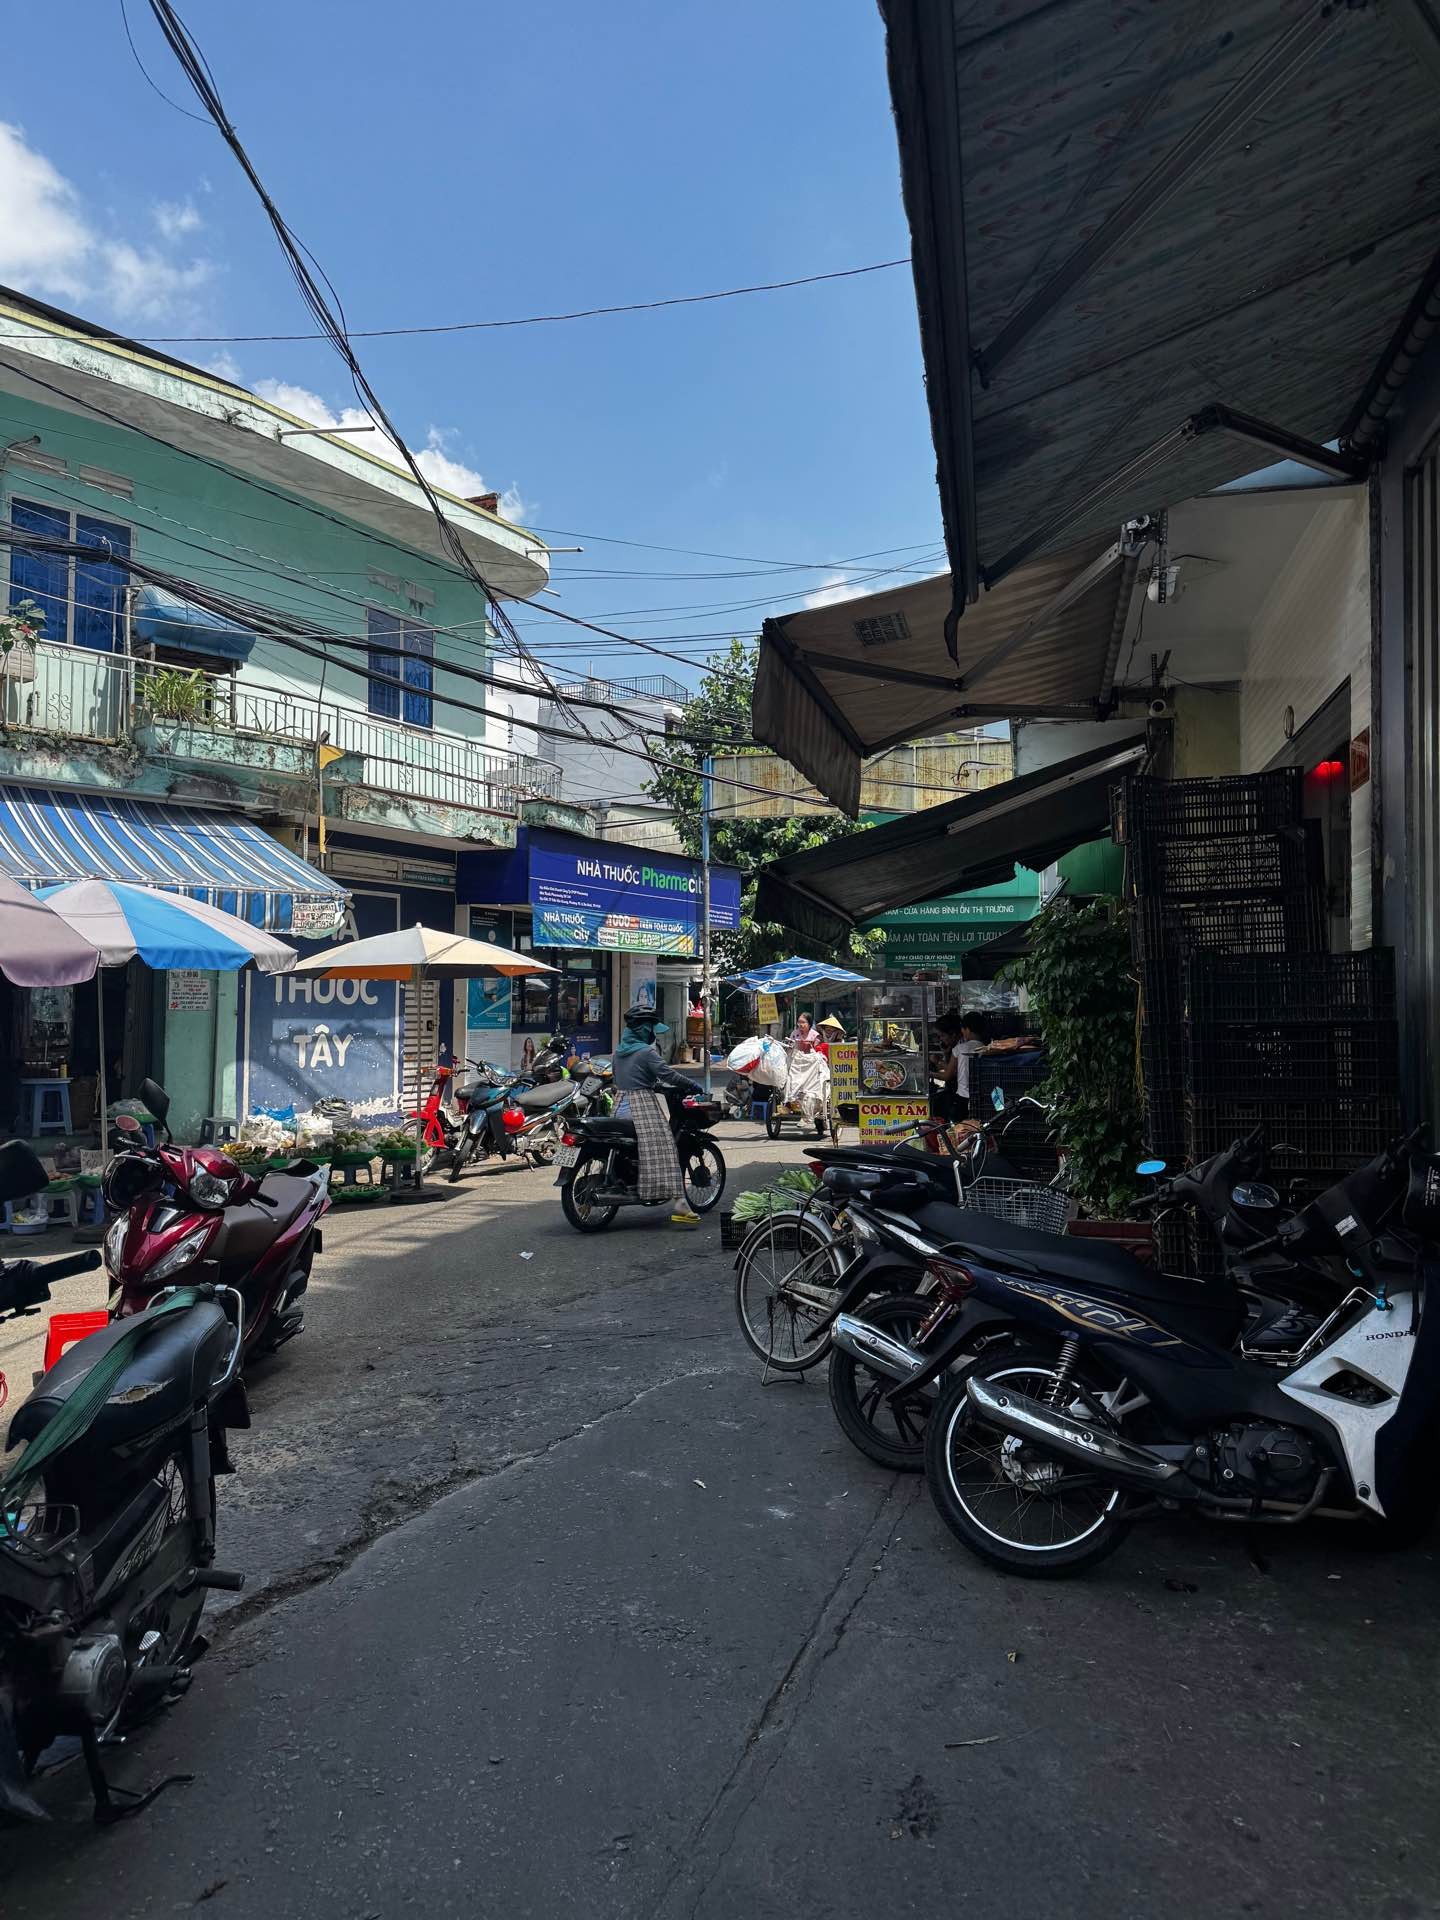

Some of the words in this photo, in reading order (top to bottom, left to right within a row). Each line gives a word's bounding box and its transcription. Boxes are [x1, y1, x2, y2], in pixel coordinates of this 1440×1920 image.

[577, 859, 601, 878] NHÀ
[603, 864, 640, 885] THUỐC
[642, 866, 704, 894] Pharmacit
[920, 905, 940, 914] HÀNG
[941, 905, 959, 914] BÌNH
[972, 906, 983, 915] THỊ
[985, 903, 1014, 913] TRƯỜNG
[544, 910, 560, 922] NHÀ
[561, 912, 586, 925] THUỐC
[903, 932, 915, 942] AN
[918, 931, 940, 942] TOÀN
[942, 930, 960, 943] TIỆN
[293, 1023, 354, 1069] TÂY
[861, 1104, 891, 1115] CƠM
[896, 1100, 928, 1116] TẤM
[1366, 1330, 1416, 1341] HONDA
